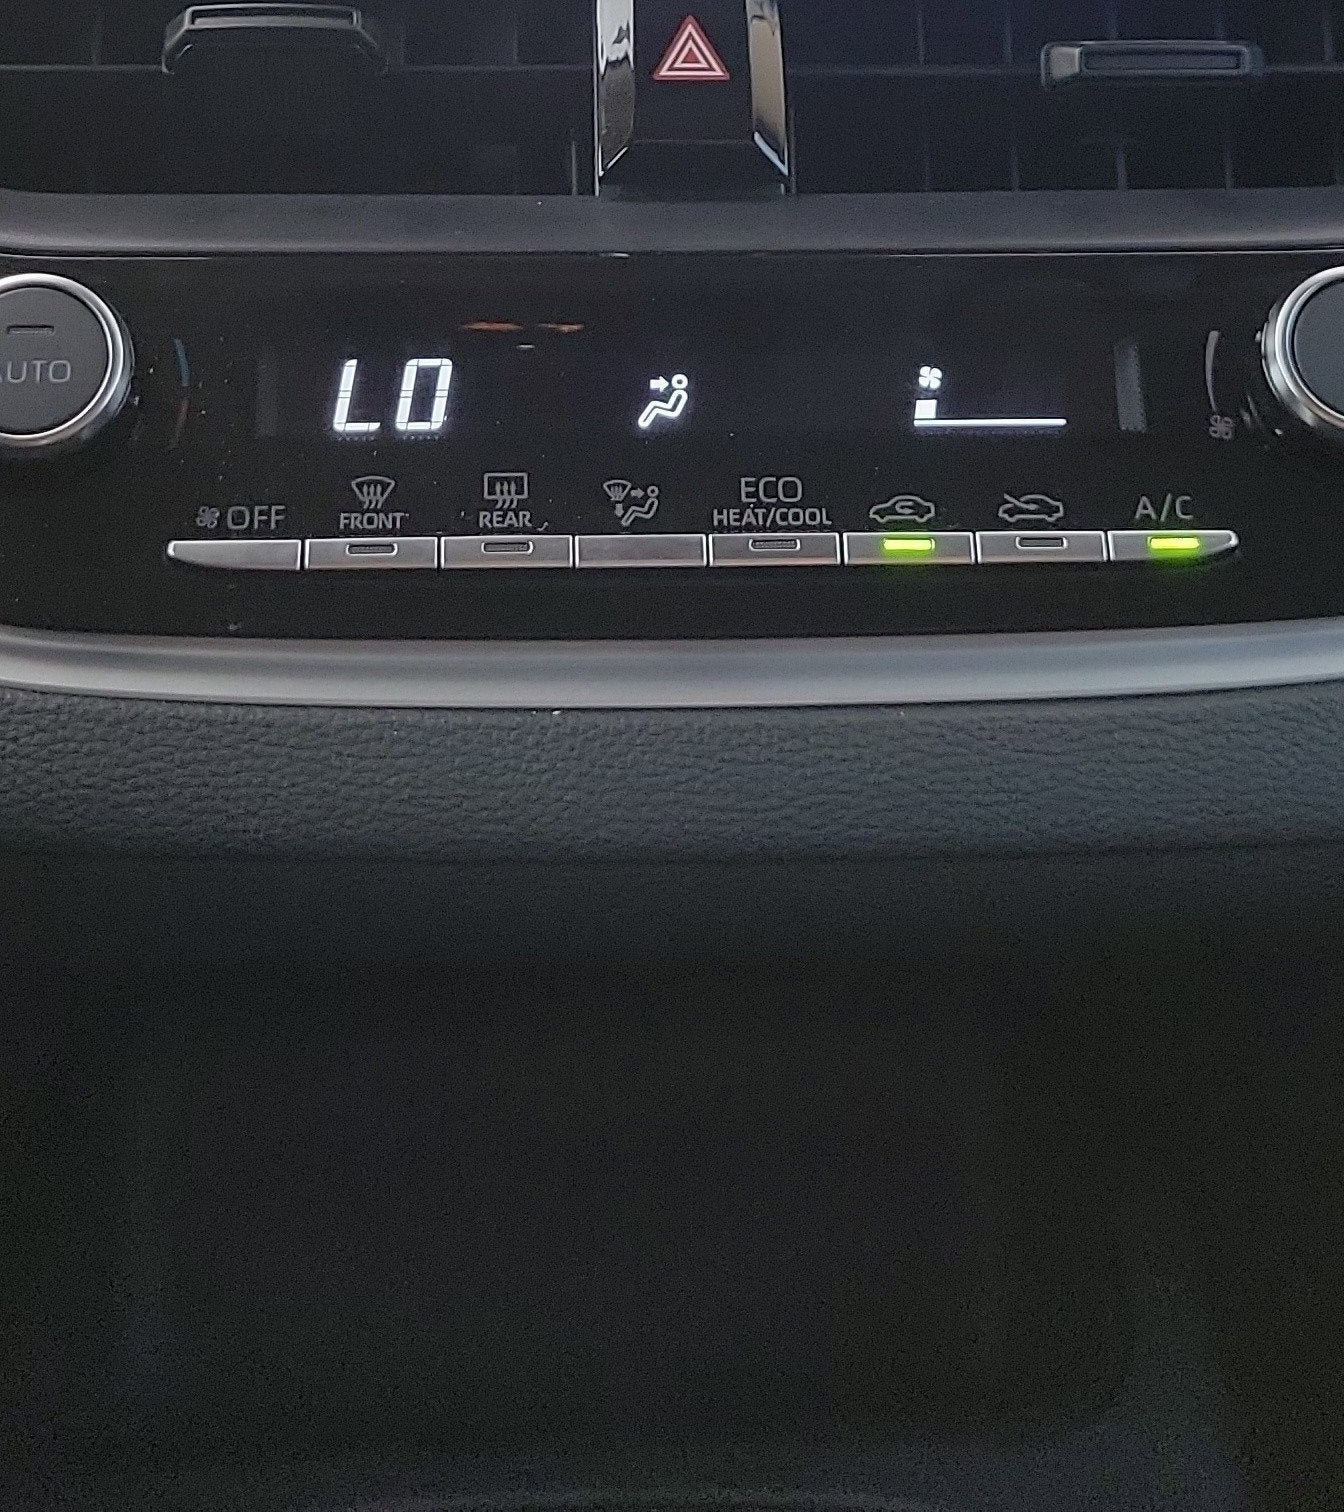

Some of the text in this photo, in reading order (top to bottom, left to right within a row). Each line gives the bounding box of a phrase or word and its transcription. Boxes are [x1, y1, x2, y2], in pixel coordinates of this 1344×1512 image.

[331, 356, 454, 432] LO
[739, 476, 804, 504] ECO
[227, 505, 286, 530] OFF
[478, 510, 533, 529] REAR
[712, 506, 833, 528] HEAT/COOL
[1135, 493, 1194, 522] A/C
[339, 511, 404, 530] FRONT
